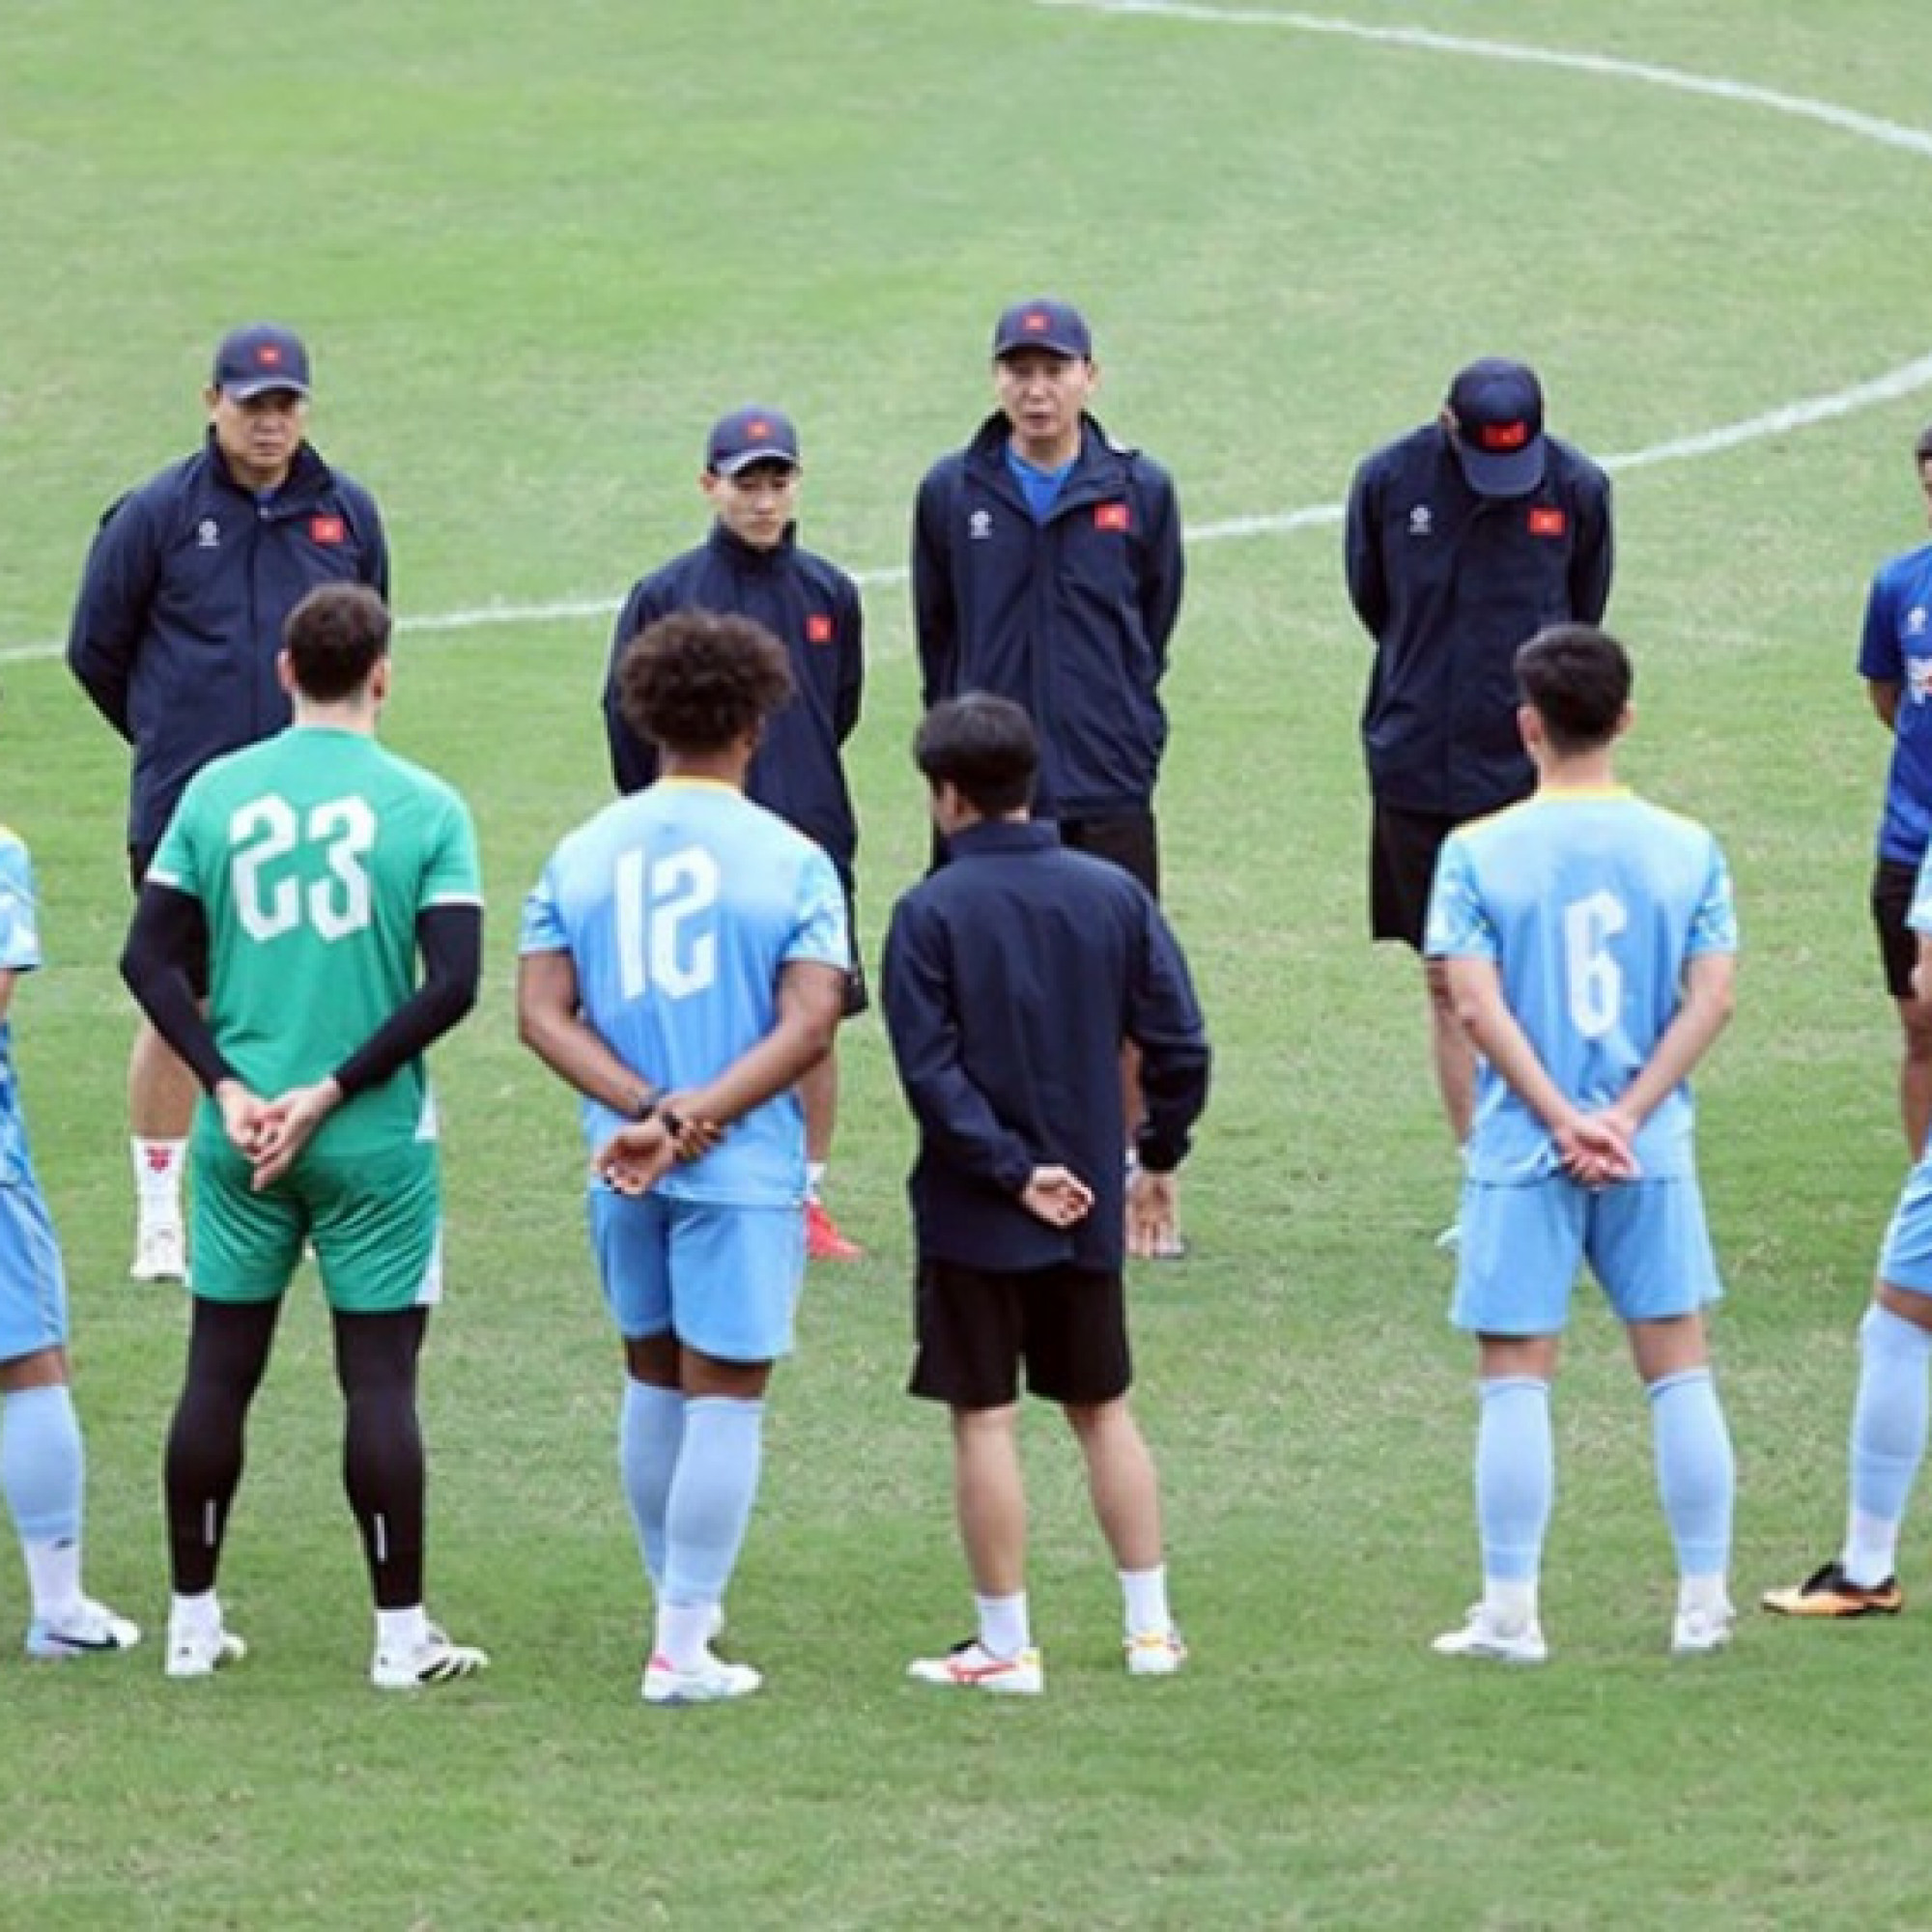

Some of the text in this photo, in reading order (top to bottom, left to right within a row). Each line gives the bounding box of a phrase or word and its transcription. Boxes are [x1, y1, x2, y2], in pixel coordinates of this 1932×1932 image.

[229, 794, 376, 941] 23
[615, 845, 718, 1000] 12
[1564, 890, 1627, 1037] 6
